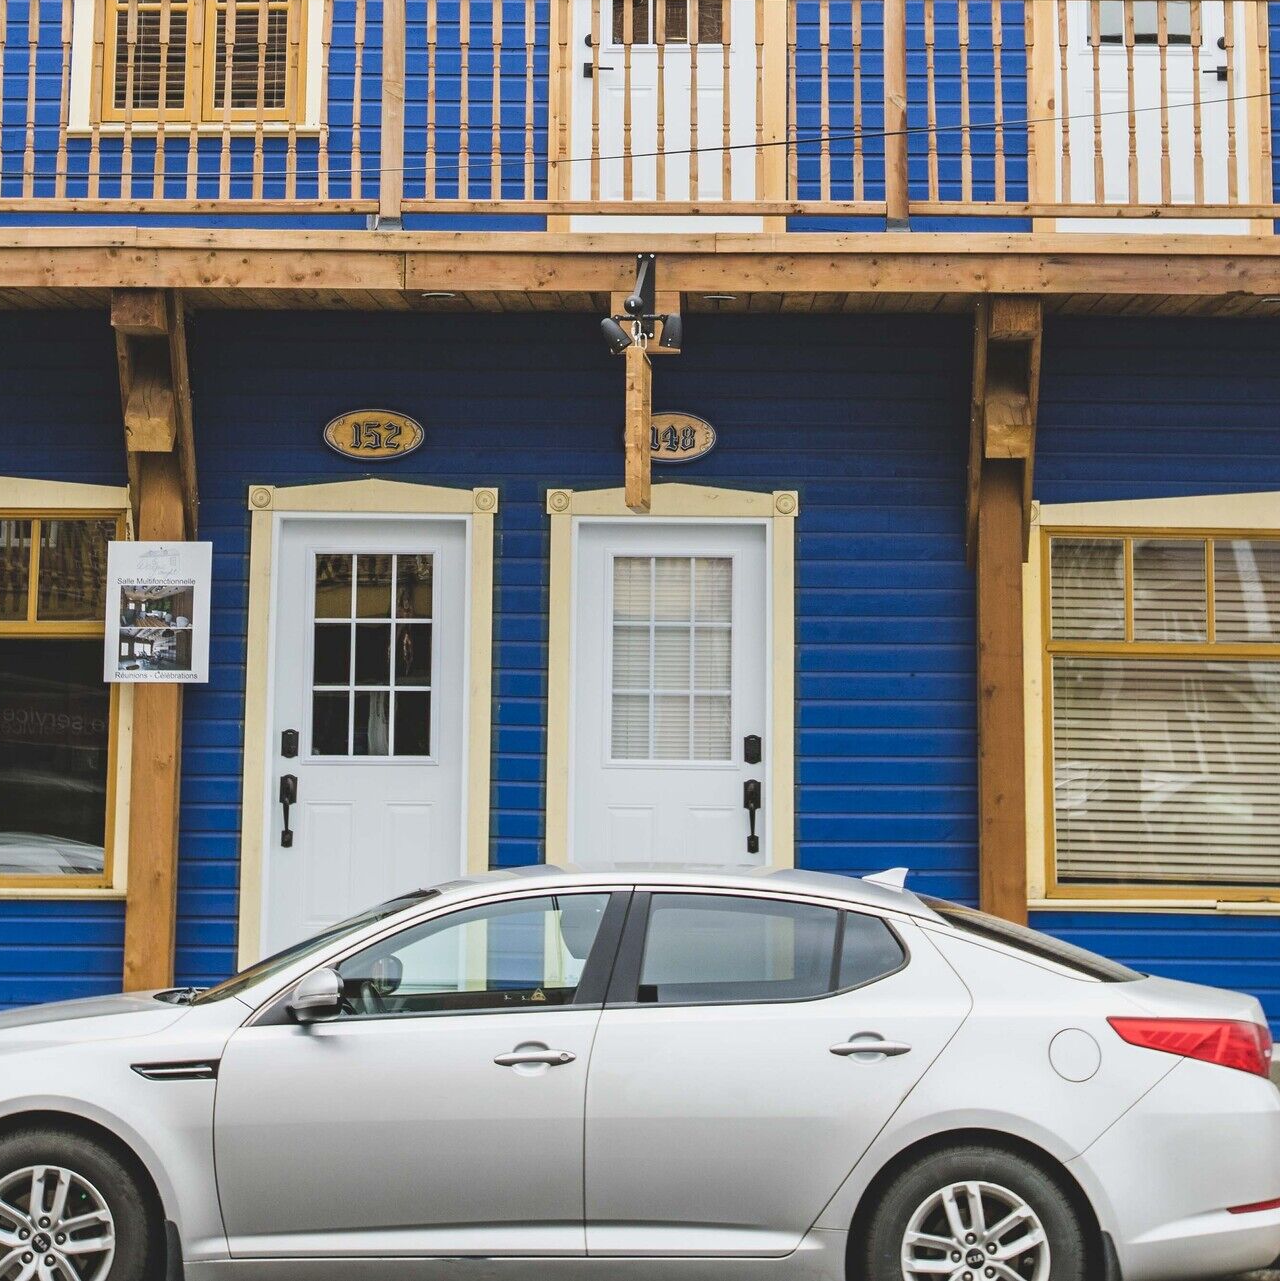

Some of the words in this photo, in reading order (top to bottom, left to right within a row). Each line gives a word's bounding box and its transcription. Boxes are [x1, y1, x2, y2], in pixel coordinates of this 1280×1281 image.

[350, 421, 402, 449] 152
[651, 424, 696, 451] 148
[117, 577, 134, 585] Salle
[137, 577, 196, 585] Multifonctionnelle
[114, 671, 148, 679] Réunions
[154, 671, 198, 680] Célébrations
